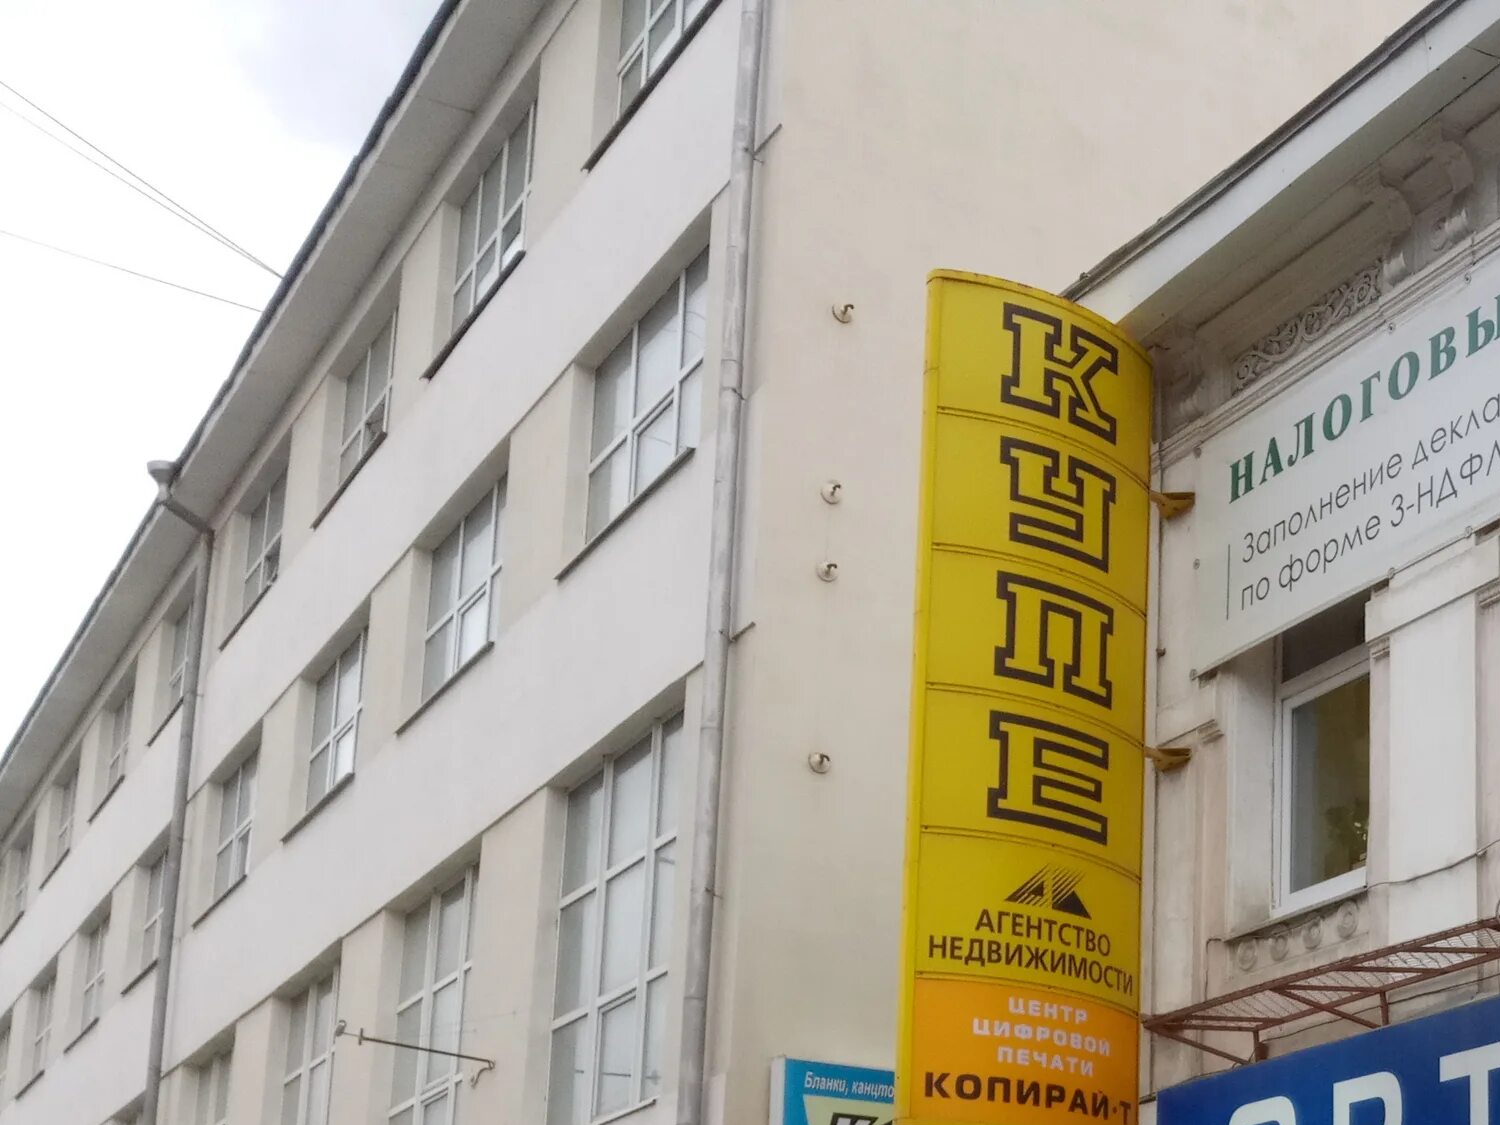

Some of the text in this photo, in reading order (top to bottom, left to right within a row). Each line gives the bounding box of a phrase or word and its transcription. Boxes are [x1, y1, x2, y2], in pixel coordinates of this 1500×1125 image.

[1242, 453, 1402, 563] Заполнение
[986, 301, 1118, 847] КУПЕ
[1240, 577, 1270, 611] по
[1279, 512, 1381, 593] форме
[975, 909, 1111, 957] АГЕНТСТВО
[928, 935, 1133, 997] НЕДВИЖИМОСТИ
[1007, 996, 1088, 1025] ЦЕНТР
[803, 1071, 848, 1095] Бланки,
[996, 1046, 1094, 1077] ПЕЧАТИ
